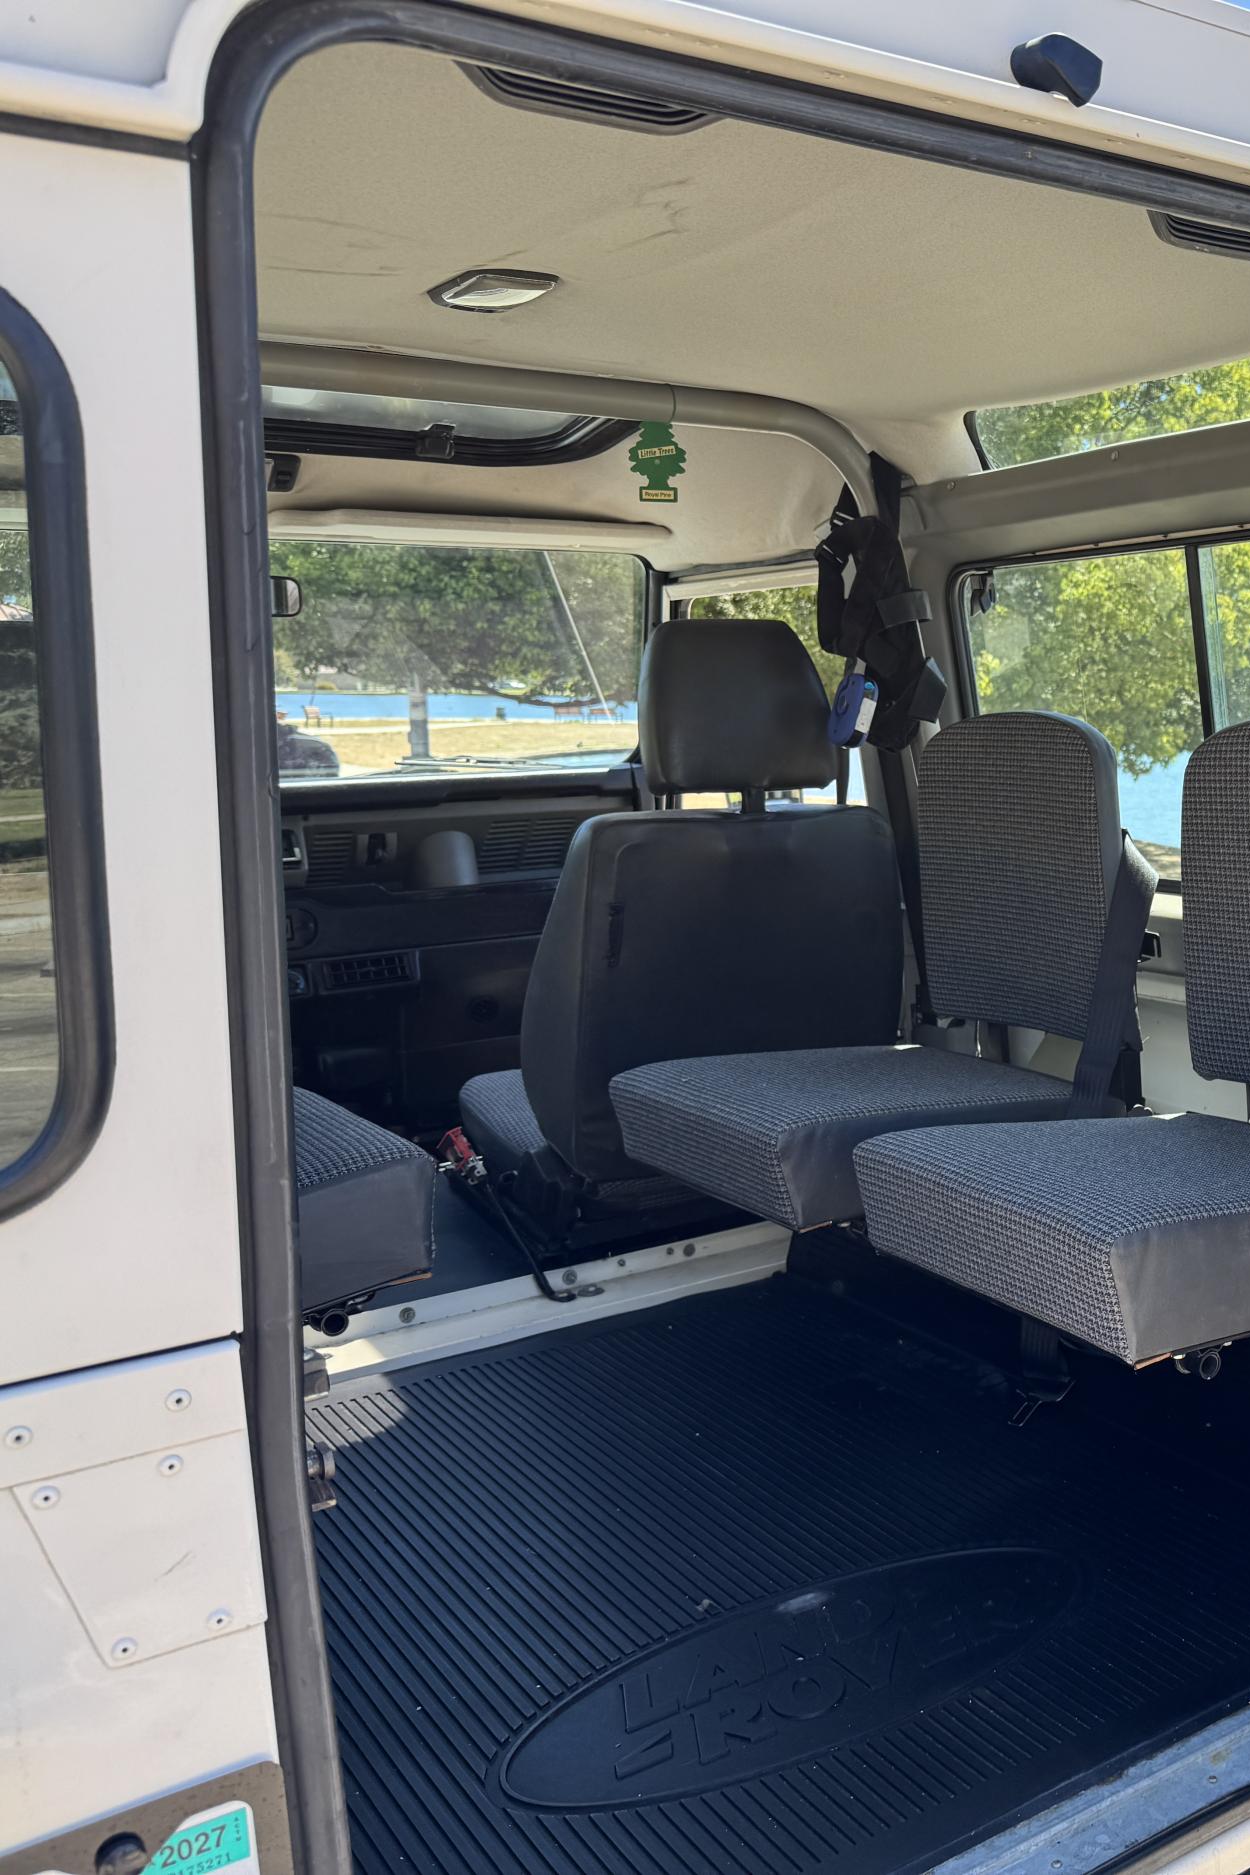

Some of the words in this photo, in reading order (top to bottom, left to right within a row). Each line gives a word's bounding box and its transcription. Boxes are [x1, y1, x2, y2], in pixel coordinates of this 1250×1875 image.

[640, 449, 657, 457] Little
[657, 447, 674, 455] Trees
[617, 1588, 896, 1733] LAND
[160, 1823, 227, 1869] 2027
